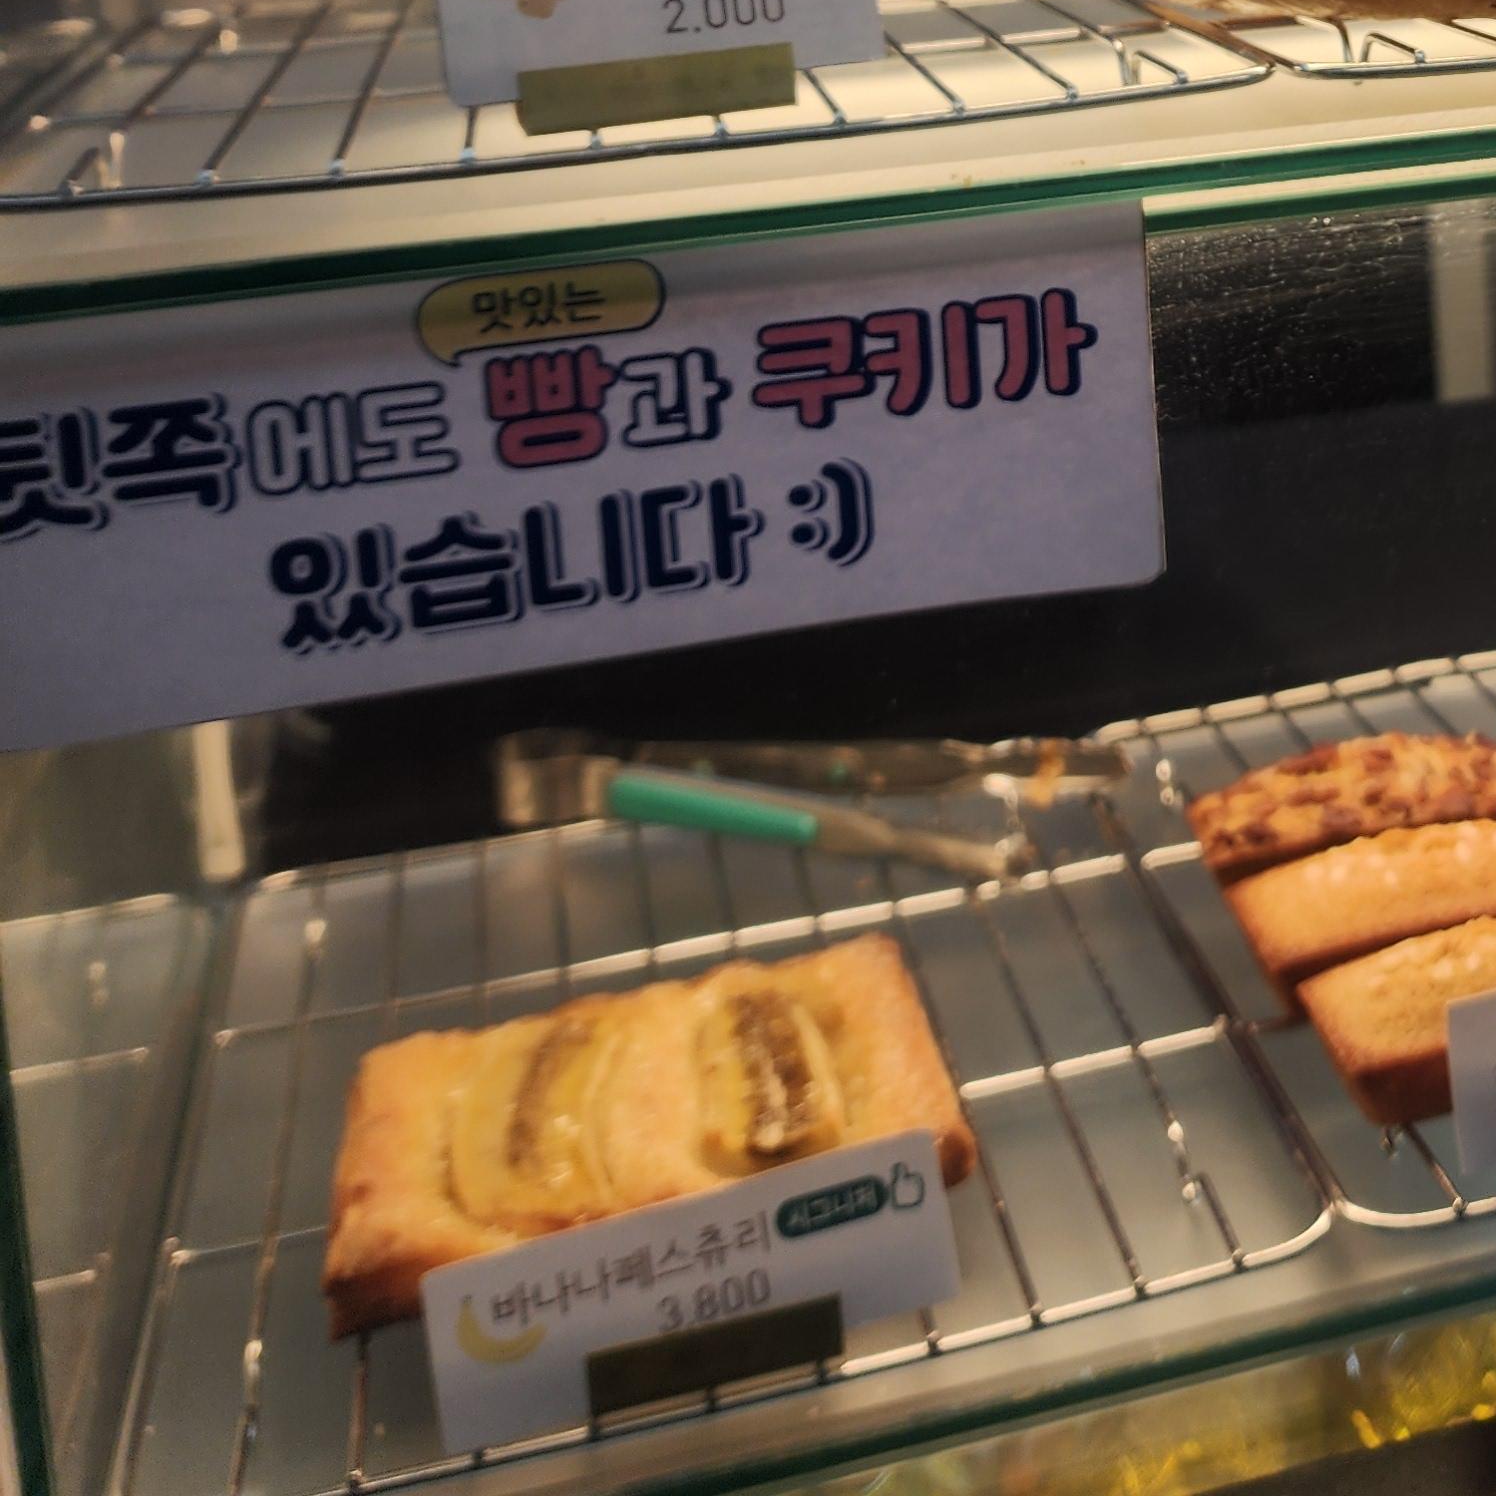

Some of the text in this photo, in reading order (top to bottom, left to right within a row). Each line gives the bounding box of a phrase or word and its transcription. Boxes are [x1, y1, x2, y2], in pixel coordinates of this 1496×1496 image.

[470, 279, 609, 334] 맛있는
[0, 287, 1098, 542] 뒷쪽에도 빵과 쿠키가
[267, 470, 766, 654] 있습니다
[657, 1268, 773, 1335] 3.800
